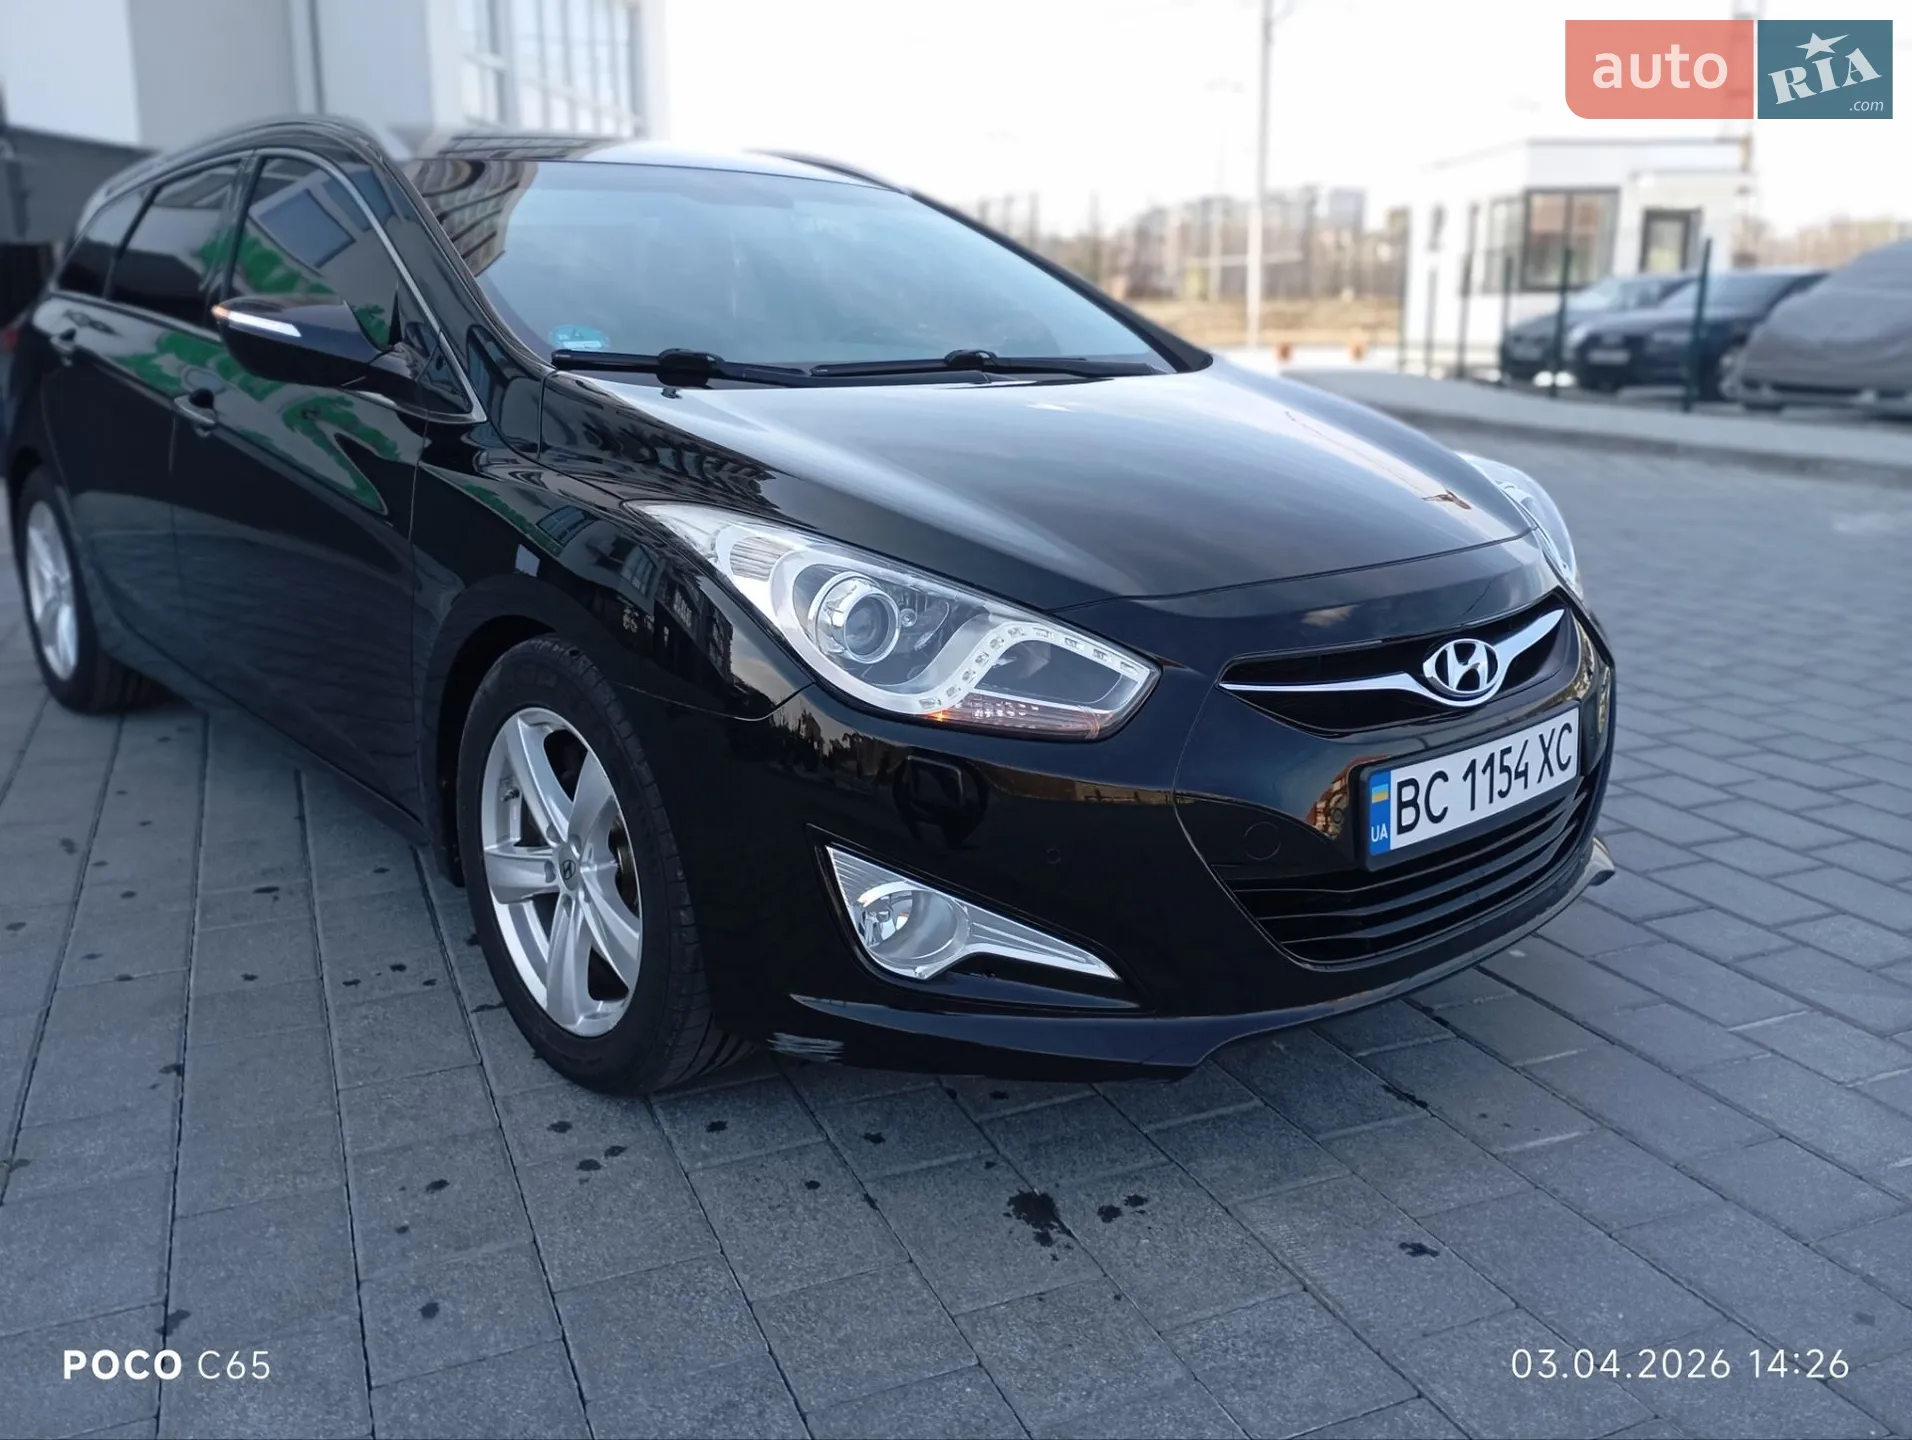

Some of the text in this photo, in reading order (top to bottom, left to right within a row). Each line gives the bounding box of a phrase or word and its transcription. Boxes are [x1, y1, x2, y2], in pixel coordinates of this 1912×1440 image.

[1396, 722, 1573, 836] BC 1154 XC
[1371, 823, 1388, 842] UA
